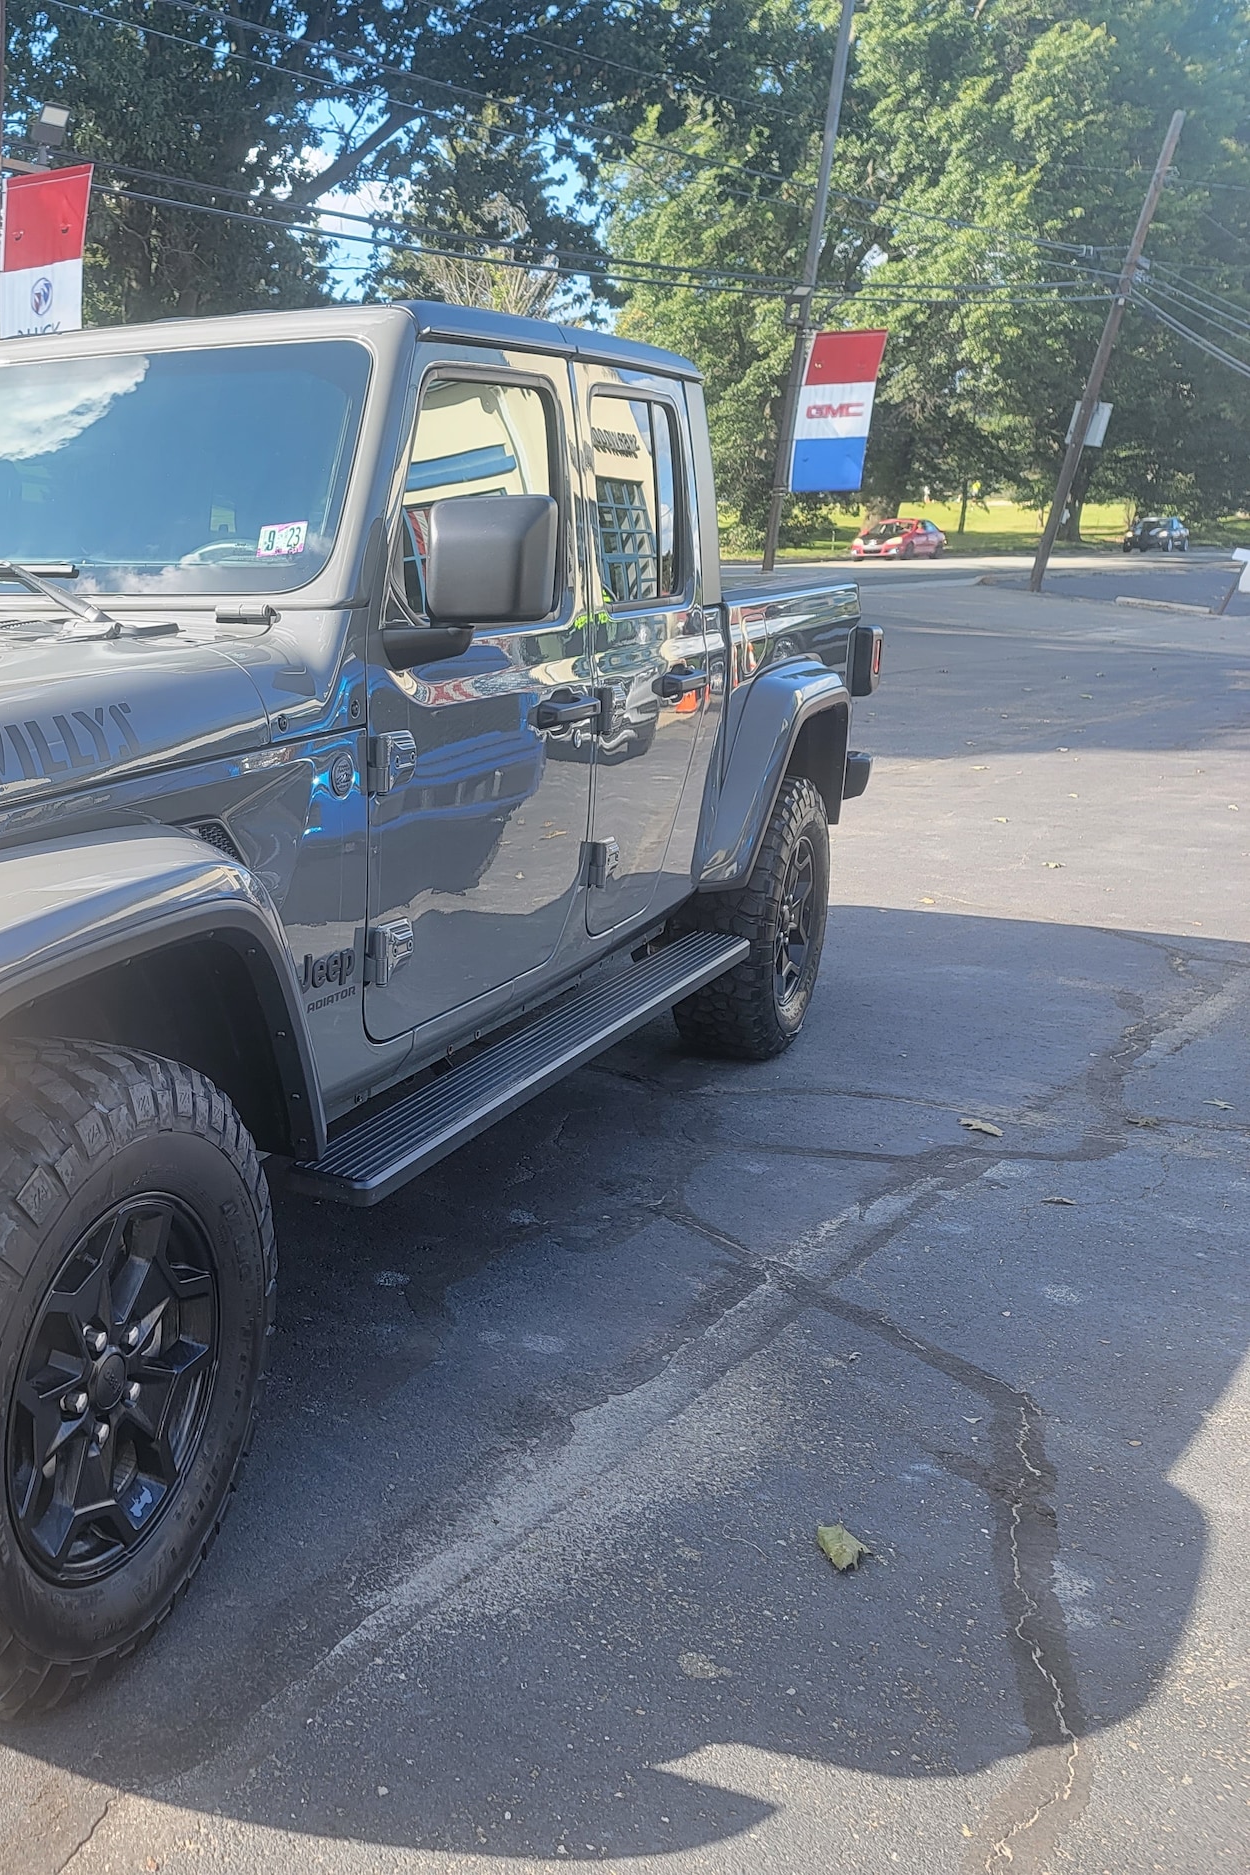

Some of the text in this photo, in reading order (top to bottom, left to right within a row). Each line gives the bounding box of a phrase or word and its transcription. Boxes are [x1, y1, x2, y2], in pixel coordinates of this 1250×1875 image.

[806, 403, 865, 419] GMC
[286, 526, 302, 548] 23
[299, 947, 356, 994] Jeep
[307, 985, 356, 1014] ADIATOR
